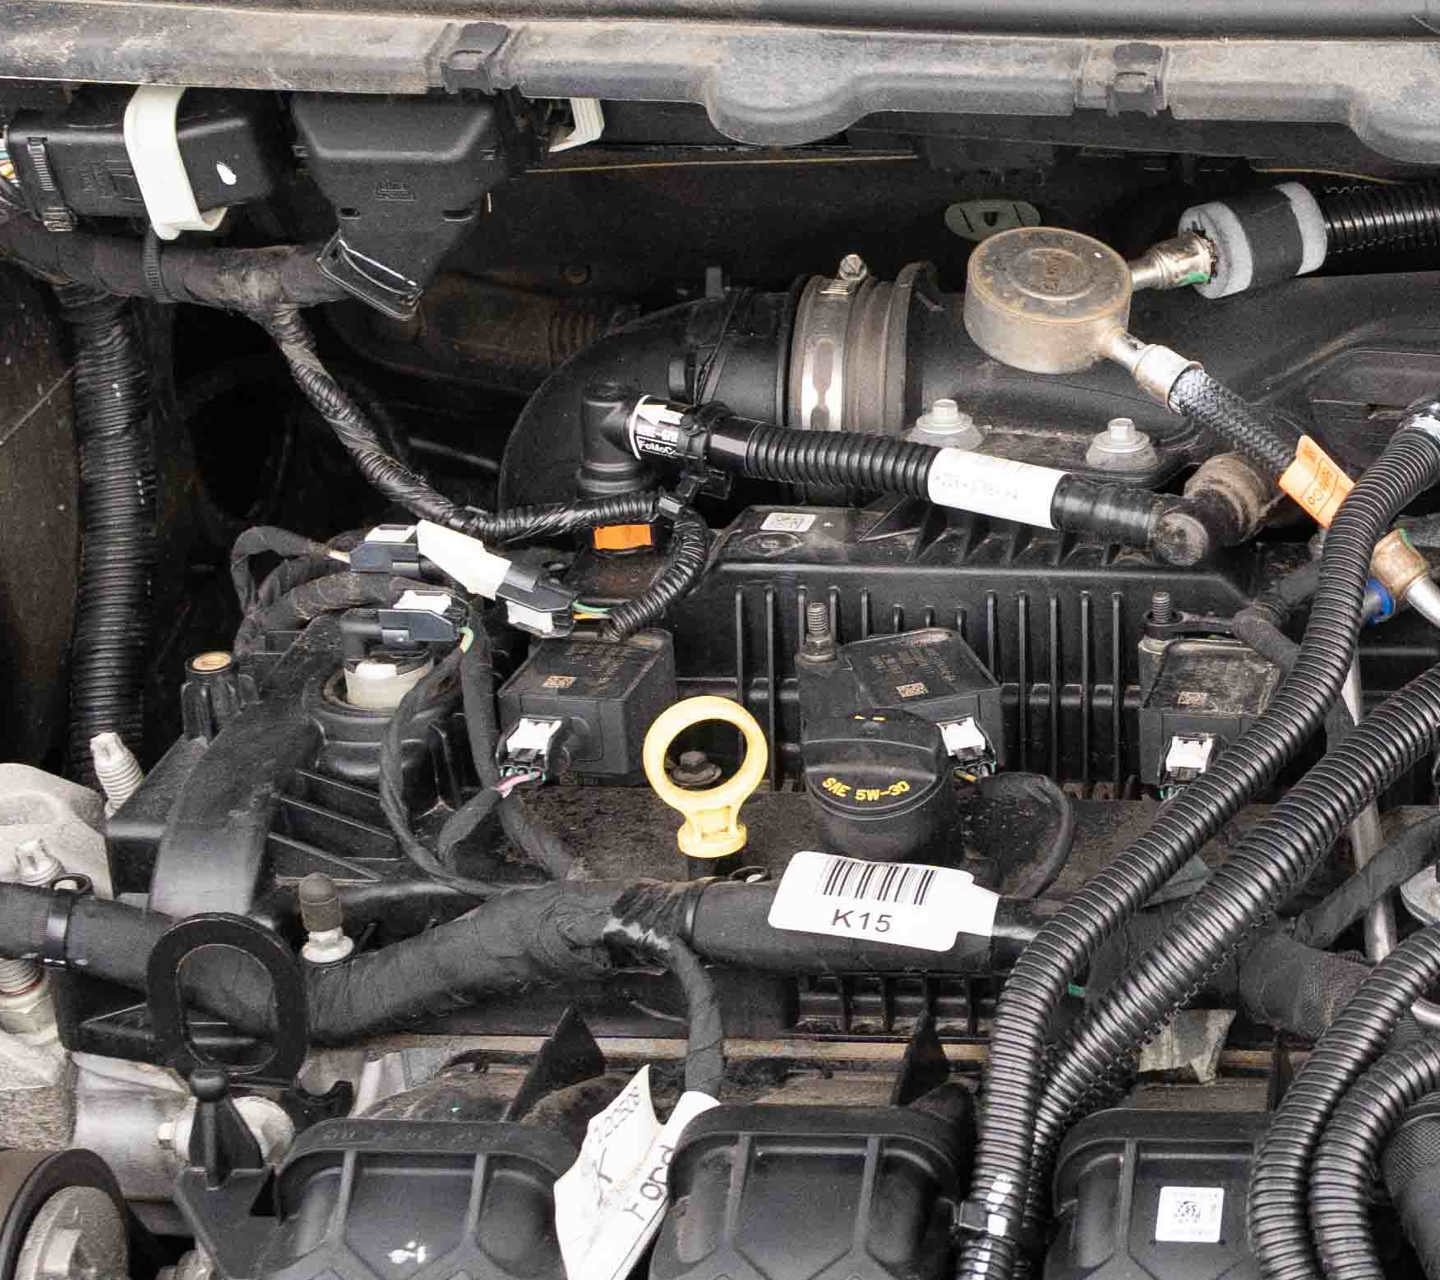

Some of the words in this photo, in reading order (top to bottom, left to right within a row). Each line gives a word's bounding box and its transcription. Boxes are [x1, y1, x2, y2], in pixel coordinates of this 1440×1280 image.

[822, 777, 851, 797] SAE
[855, 780, 910, 801] 5W-30
[831, 908, 893, 933] K15
